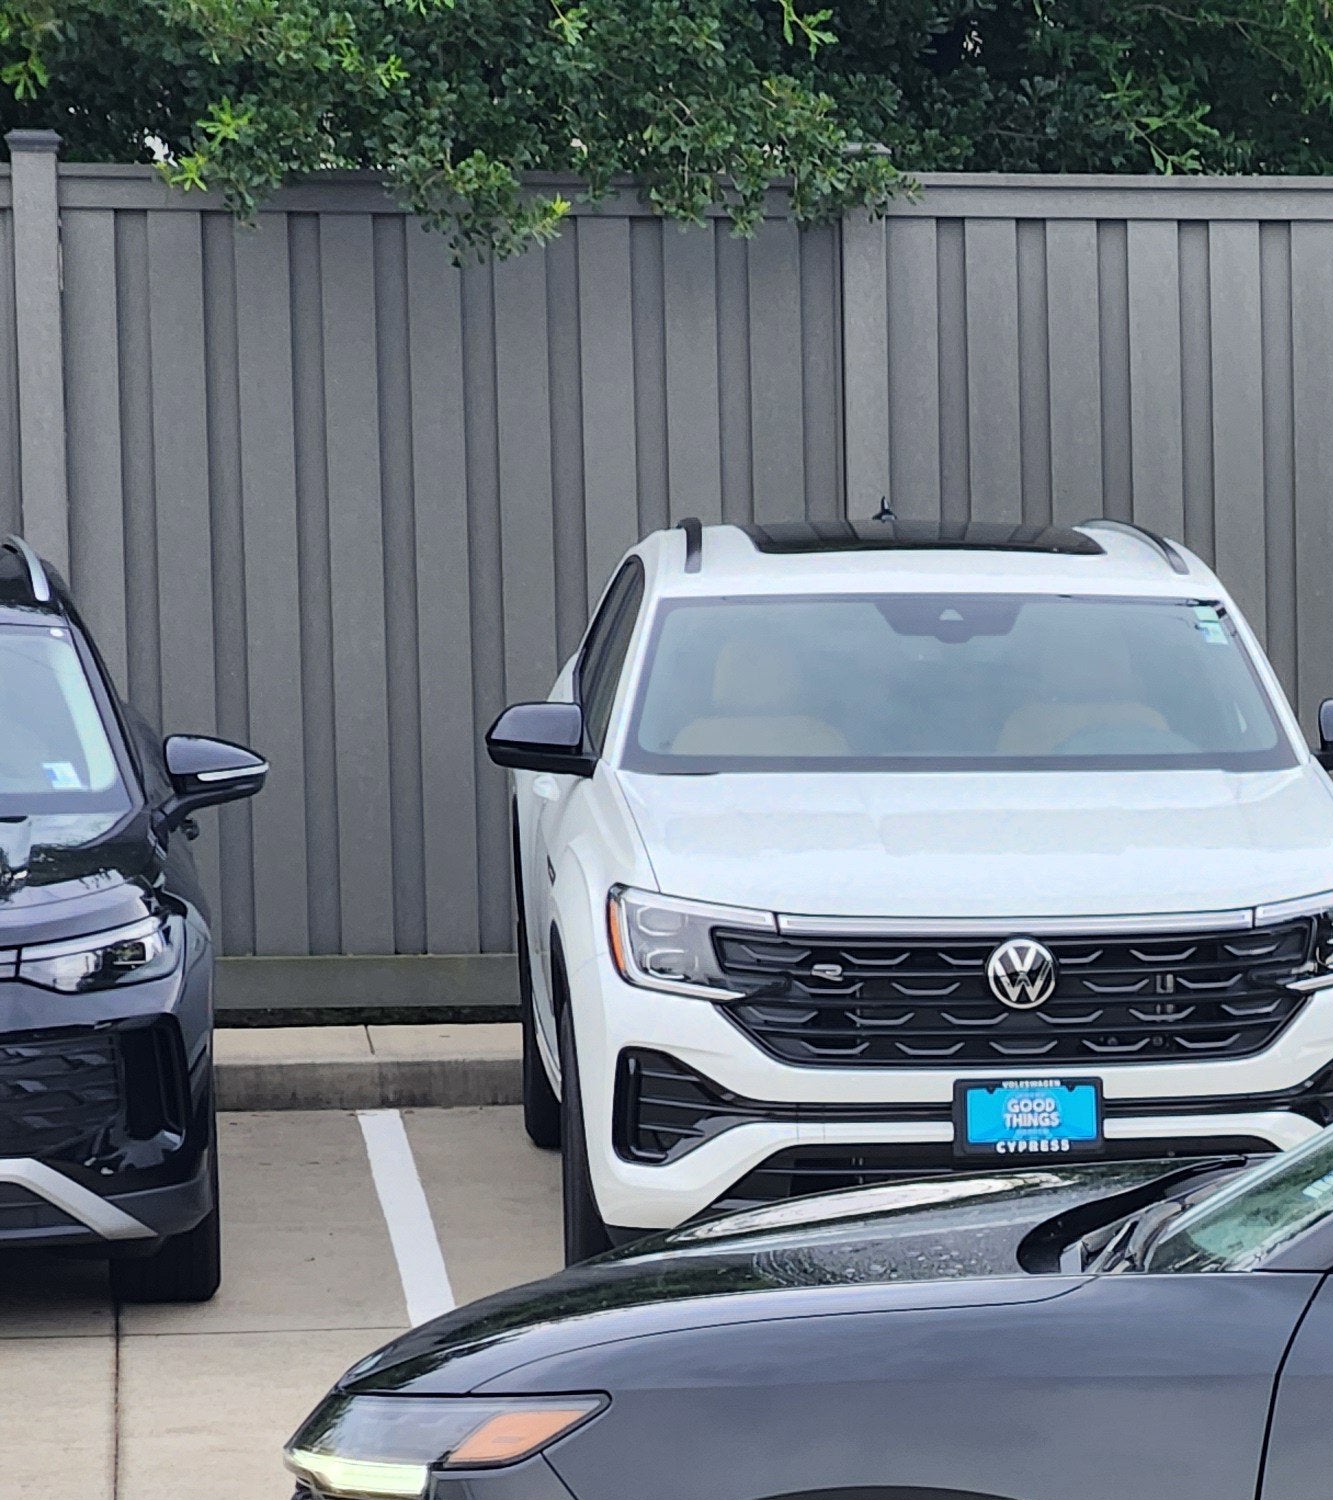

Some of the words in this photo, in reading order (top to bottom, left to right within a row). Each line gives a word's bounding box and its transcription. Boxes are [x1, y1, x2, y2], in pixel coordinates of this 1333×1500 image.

[1001, 1079, 1061, 1089] VOLKSWAGEN
[1007, 1098, 1056, 1113] GOOD
[1004, 1112, 1061, 1129] THINGS
[995, 1138, 1070, 1154] CYPRESS
